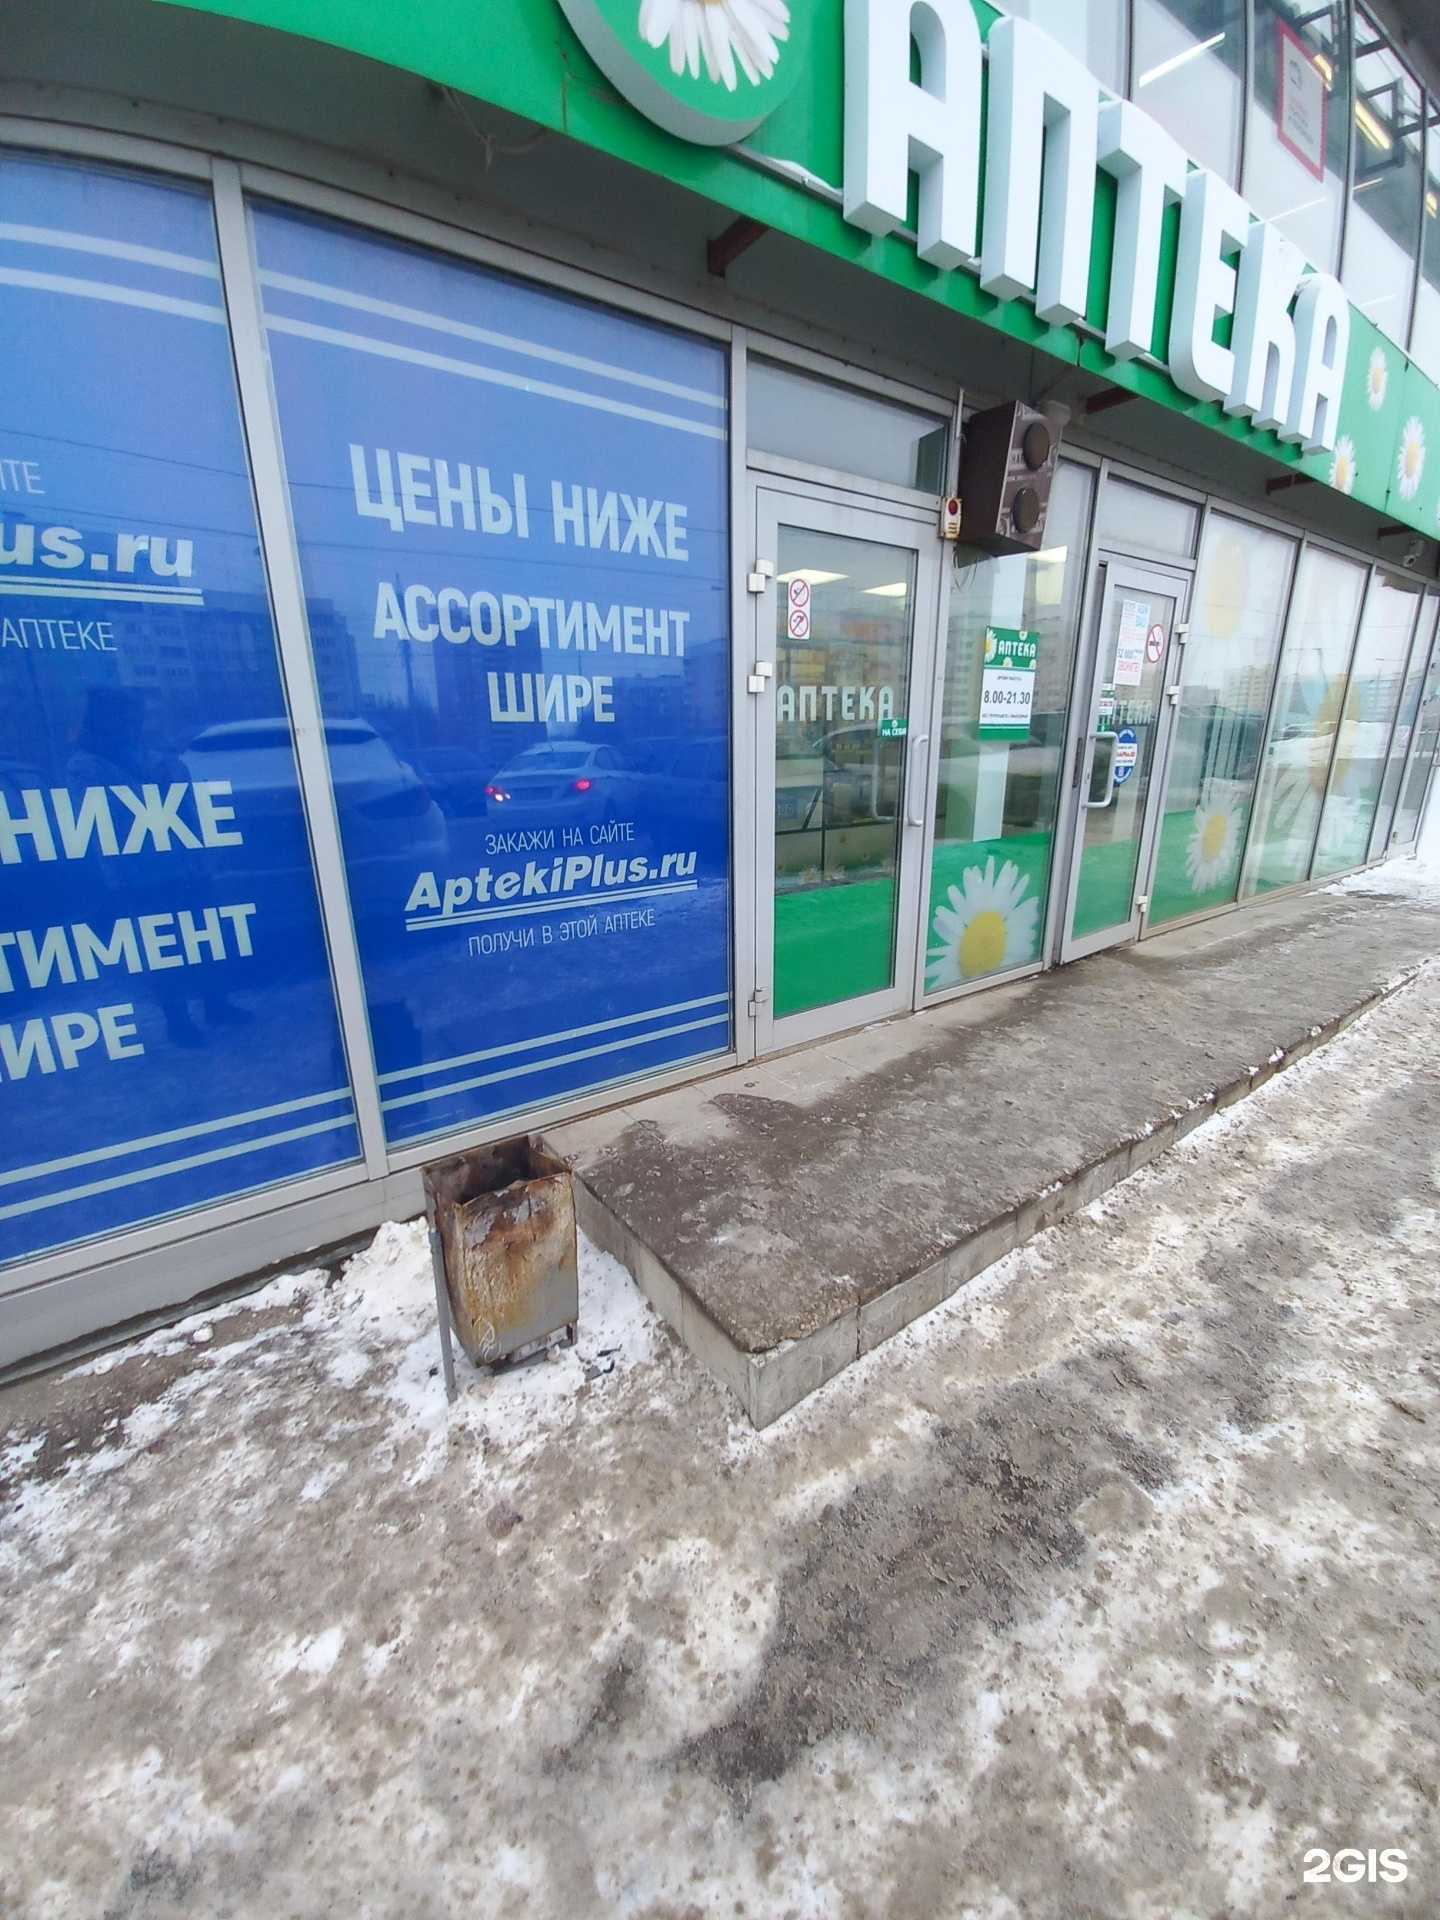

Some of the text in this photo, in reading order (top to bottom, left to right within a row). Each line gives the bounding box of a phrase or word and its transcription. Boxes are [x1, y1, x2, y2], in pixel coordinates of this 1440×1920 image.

[842, 0, 1350, 455] АПТЕКА
[0, 459, 46, 494] ТЕ
[349, 443, 689, 562] ЦЕНЫ НИЖЕ
[2, 617, 118, 651] АПТЕКЕ
[373, 582, 690, 657] АССОРТИМЕНТ
[998, 640, 1037, 657] АПТЕКА
[487, 671, 615, 723] ШИРЕ
[776, 684, 894, 722] АПТЕКА
[984, 690, 1031, 705] 8.00-21.30
[0, 780, 244, 865] НИЖЕ
[485, 819, 635, 856] ЗАКАЖИ НА САЙТЕ
[404, 851, 697, 917] AptekiPlus.ru
[468, 908, 656, 957] ПОЛУЧИ В ЭТОЙ АПТЕКЕ
[0, 1003, 145, 1084] ИРЕ
